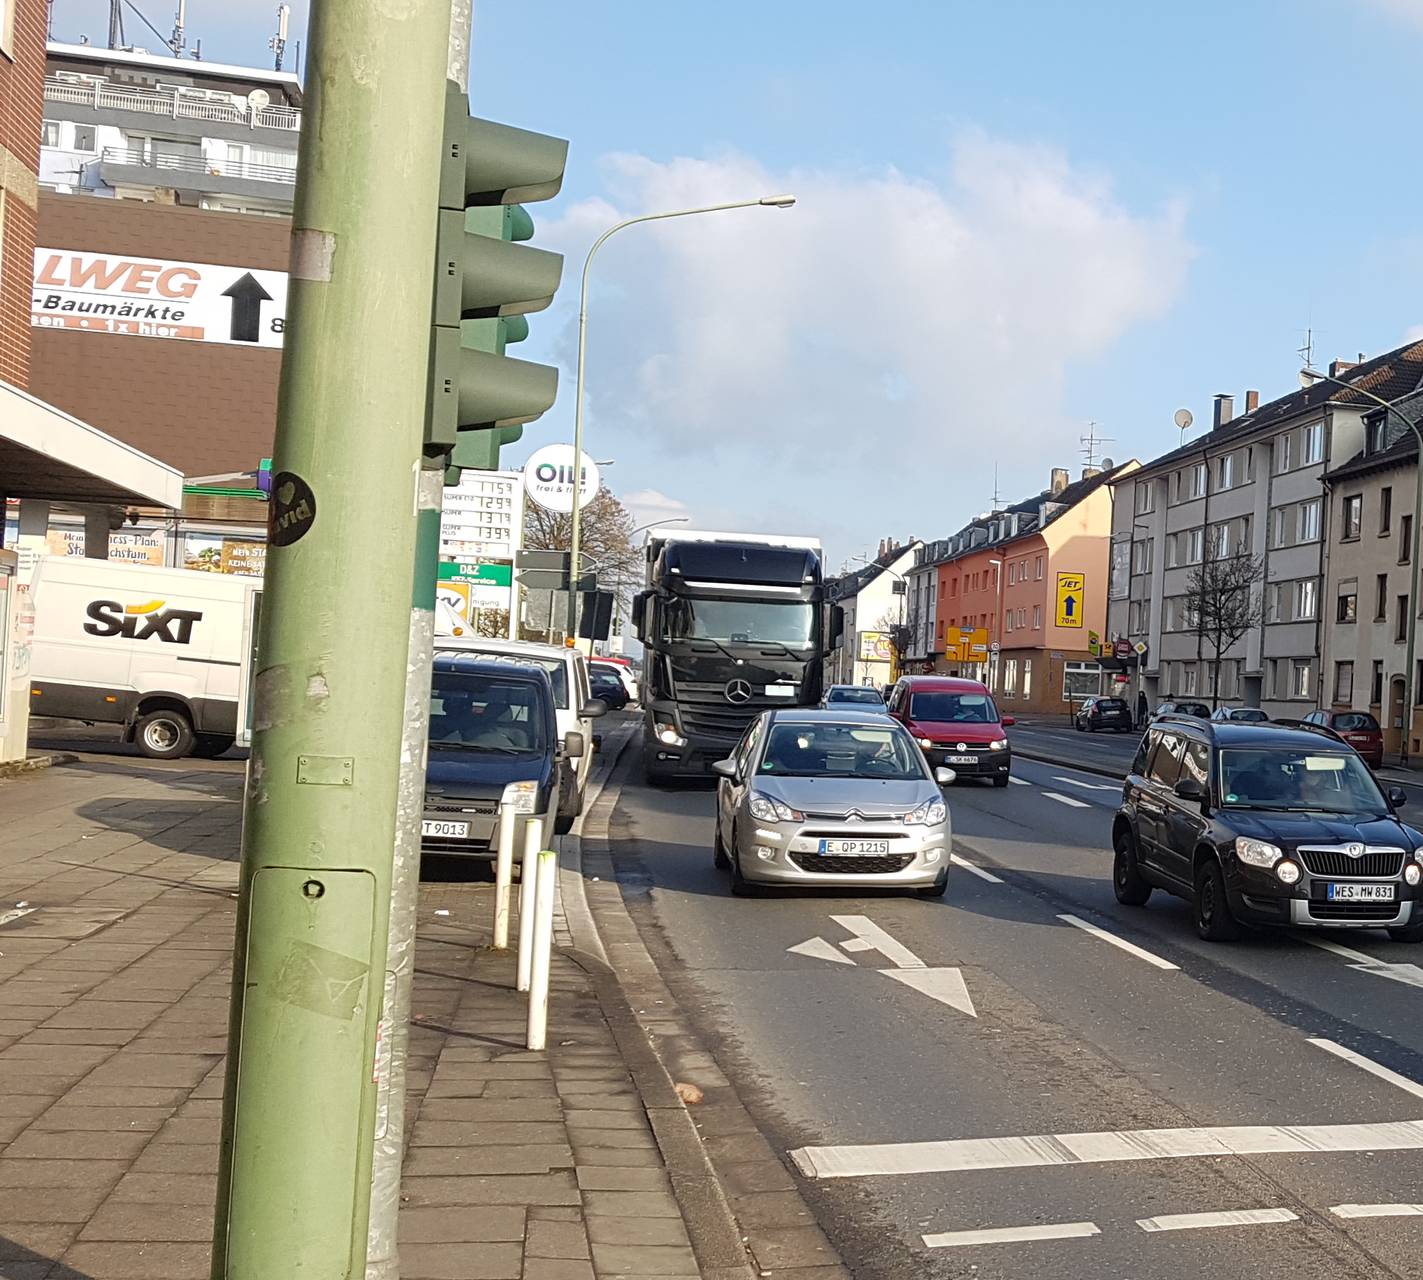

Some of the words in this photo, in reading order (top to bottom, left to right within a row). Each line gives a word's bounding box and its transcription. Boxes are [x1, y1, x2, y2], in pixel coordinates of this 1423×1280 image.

[33, 294, 185, 322] -Baumärkte
[106, 319, 129, 333] 1x
[138, 322, 179, 337] hier
[535, 463, 586, 485] OIL!
[535, 484, 554, 492] frei
[565, 486, 587, 495] fltt
[459, 564, 480, 575] D&Z
[1061, 580, 1080, 588] JET
[434, 823, 465, 835] 9013
[861, 843, 886, 854] 1215
[1375, 886, 1393, 899] 831
